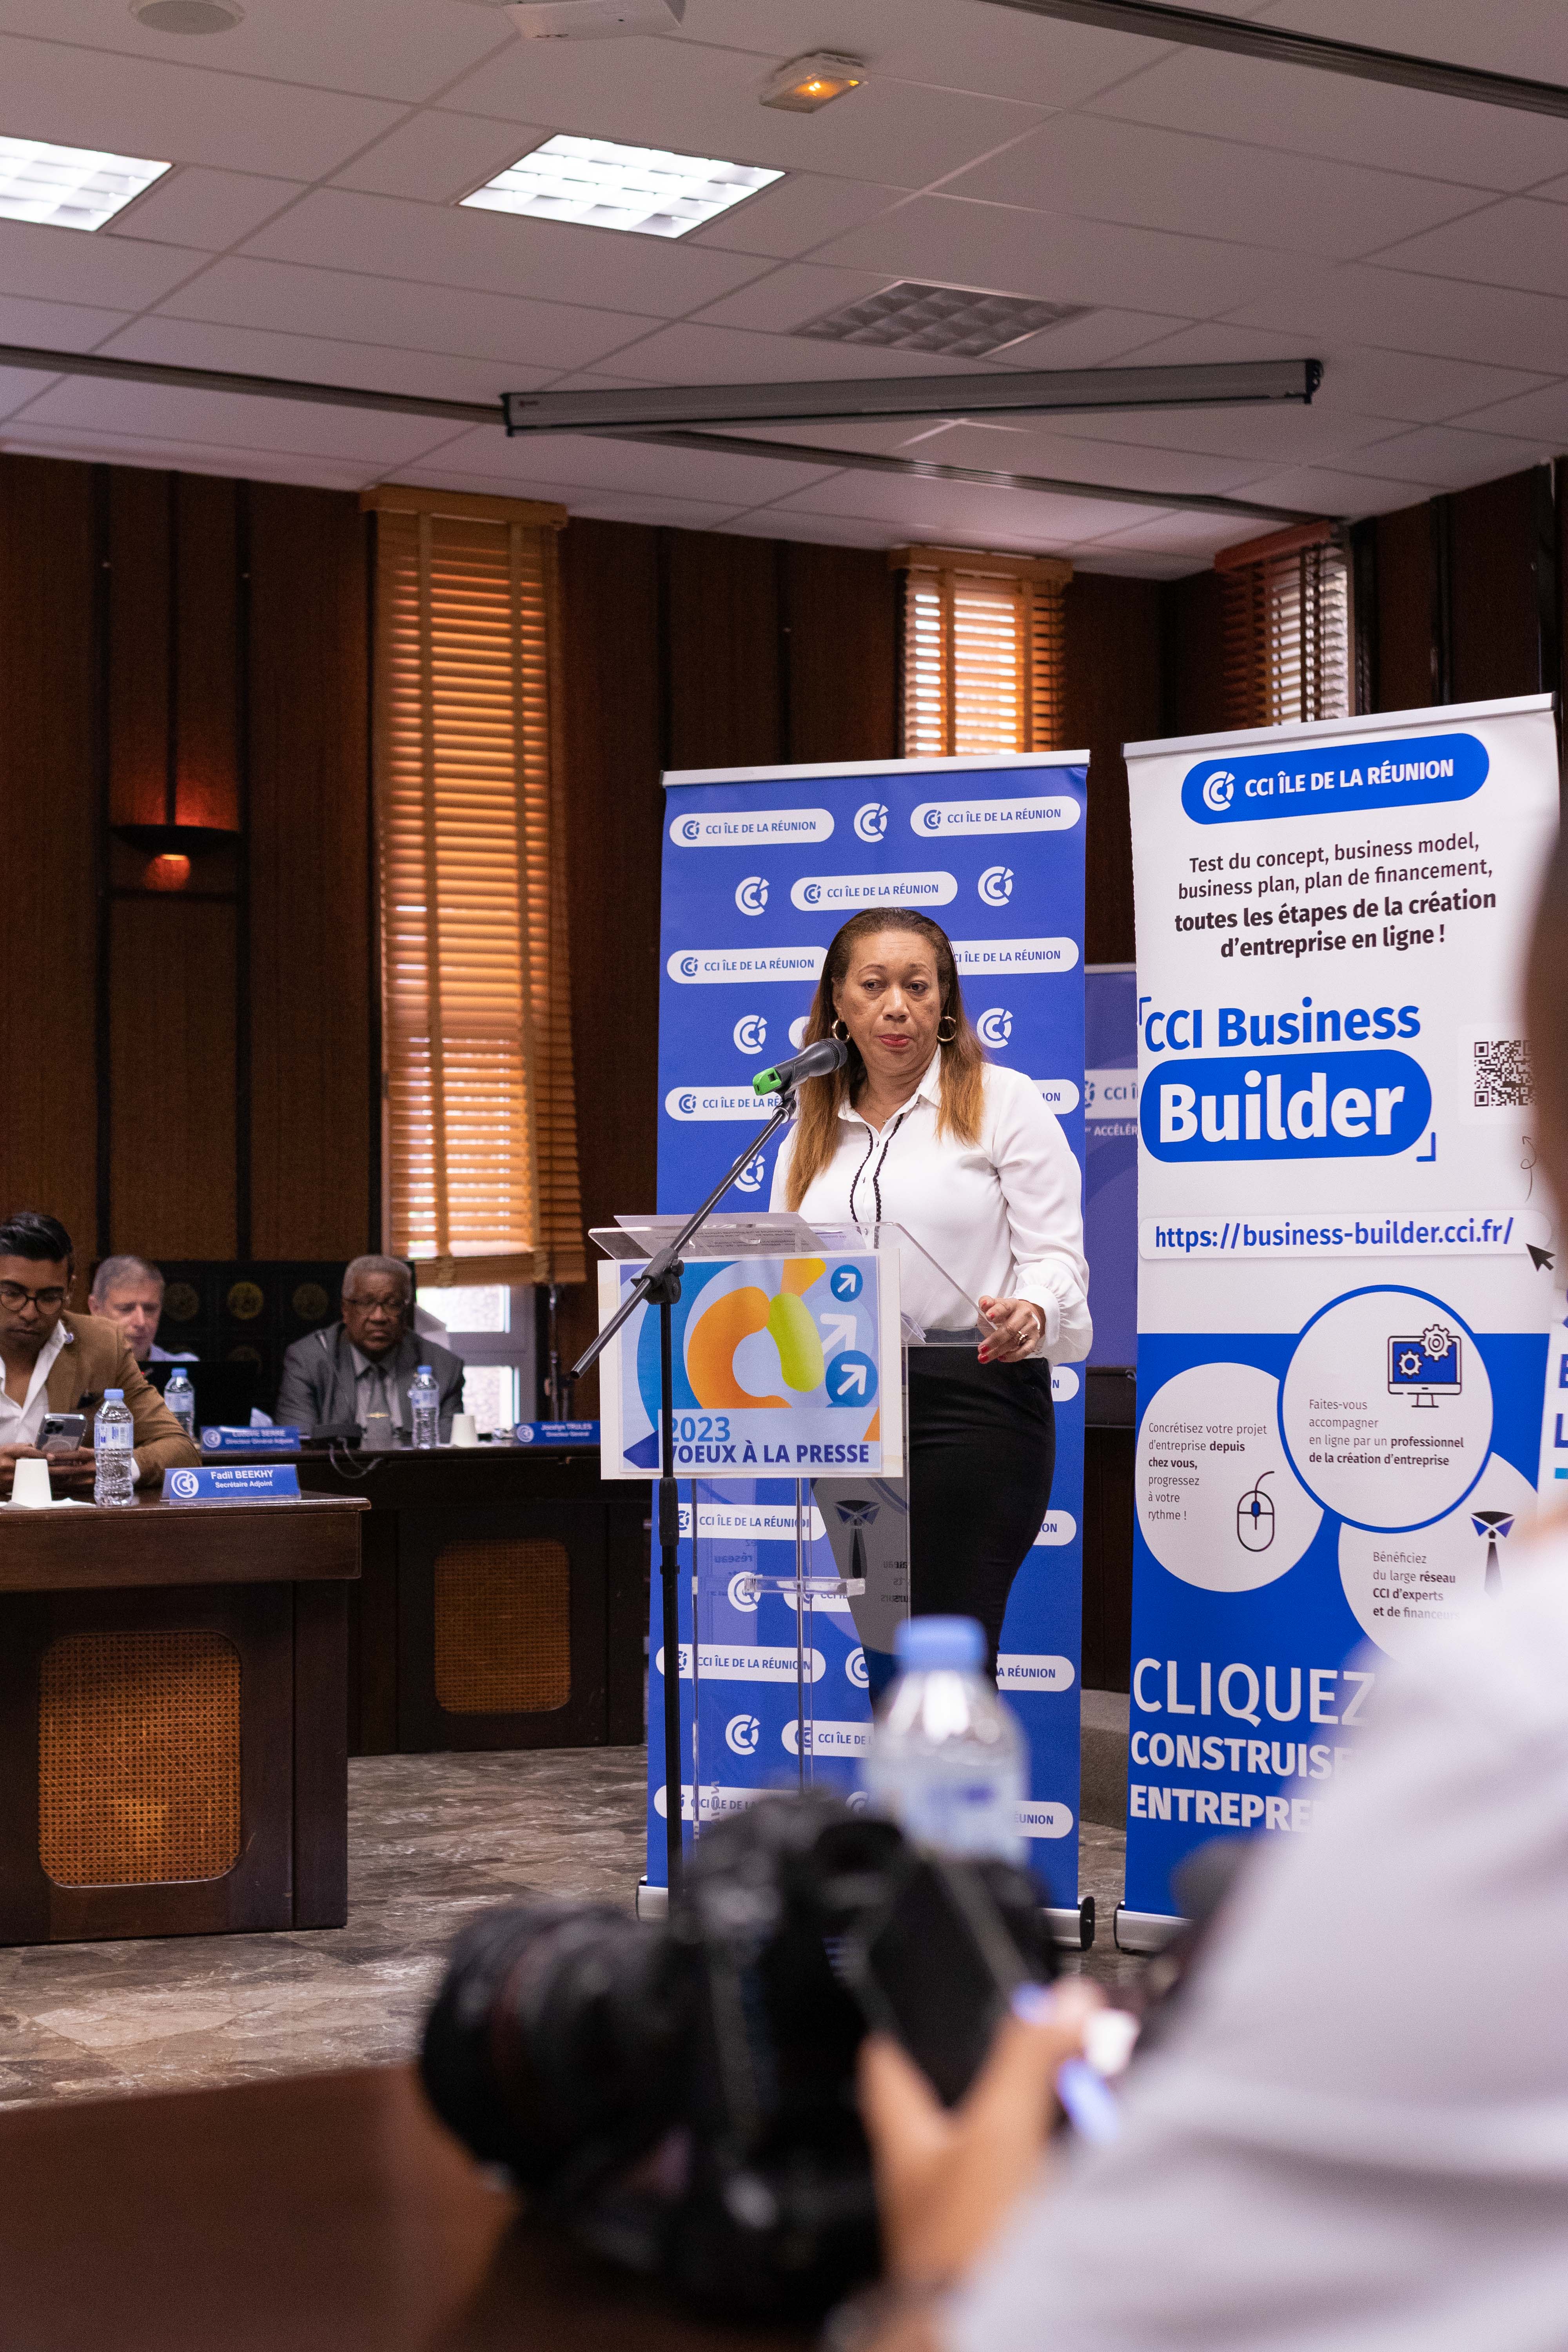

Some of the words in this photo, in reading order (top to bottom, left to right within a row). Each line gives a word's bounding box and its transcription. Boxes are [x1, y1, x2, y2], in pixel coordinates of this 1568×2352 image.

[1245, 778, 1273, 797] CCI
[1278, 771, 1305, 793] ÎLE
[1311, 771, 1334, 790] DE
[1340, 769, 1363, 787] LA
[1368, 759, 1453, 785] RÉUNION
[947, 814, 963, 823] CCI
[966, 811, 981, 822] ÎLE
[985, 813, 997, 821] DE
[1001, 812, 1013, 820] LA
[1016, 808, 1060, 820] RÉUNION
[706, 826, 721, 834] CCI
[724, 822, 739, 833] ÎLE
[742, 824, 753, 833] DE
[757, 824, 768, 832] LA
[771, 820, 816, 831] RÉUNION
[1189, 856, 1223, 873] Test
[1229, 853, 1250, 869] du
[1257, 848, 1328, 867] concept,
[1335, 840, 1412, 860] business
[1419, 831, 1479, 853] model,
[1179, 879, 1252, 899] business
[1259, 876, 1299, 897] plan,
[1305, 871, 1341, 893] plan
[1348, 868, 1369, 885] de
[1375, 859, 1492, 883] financement,
[828, 889, 842, 897] CCI
[845, 886, 860, 897] ÎLE
[863, 887, 875, 896] DE
[878, 887, 890, 895] LA
[893, 883, 938, 894] RÉUNION
[1175, 912, 1238, 932] toutes
[1244, 907, 1273, 927] les
[1279, 903, 1347, 927] étapes
[1353, 898, 1378, 918] de
[1385, 897, 1403, 916] la
[1409, 888, 1495, 914] création
[1221, 930, 1346, 958] d'entreprise
[1352, 935, 1376, 949] en
[1383, 925, 1434, 951] ligne
[965, 951, 980, 962] ÎLE
[984, 953, 996, 962] DE
[1000, 953, 1012, 961] LA
[1015, 949, 1060, 960] RÉUNION
[704, 962, 719, 971] CCI
[722, 959, 737, 971] ÎLE
[740, 962, 752, 970] DE
[755, 961, 766, 969] LA
[769, 958, 814, 969] RÉUNION
[1145, 1010, 1202, 1052] CCI
[1219, 997, 1420, 1047] Business
[1104, 1087, 1127, 1100] CCI
[703, 1100, 718, 1108] CCI
[721, 1097, 735, 1108] ÎLE
[738, 1099, 750, 1107] DE
[753, 1099, 764, 1107] LA
[1160, 1070, 1405, 1143] Builder
[1156, 1217, 1514, 1252] https://business-builder.cci.fr/
[1310, 1399, 1367, 1410] Faites-vous
[1149, 1422, 1203, 1433] Concrétisez
[1206, 1425, 1233, 1434] votre
[1237, 1424, 1267, 1436] projet
[1309, 1419, 1378, 1430] accompagner
[1149, 1440, 1206, 1453] d'entreprise
[1210, 1441, 1245, 1454] depuis
[1325, 1434, 1350, 1448] ligne
[1354, 1438, 1371, 1448] par
[1391, 1436, 1464, 1448] professionnel
[742, 1440, 757, 1463] À
[764, 1445, 789, 1463] LA
[797, 1445, 868, 1463] PRESSE
[1149, 1457, 1168, 1467] chez
[1171, 1460, 1197, 1470] vous,
[1309, 1452, 1322, 1462] de
[1325, 1453, 1334, 1463] la
[1337, 1452, 1381, 1463] création
[1384, 1454, 1449, 1467] d'entreprise
[235, 1470, 273, 1479] BEEKHY
[1149, 1477, 1199, 1487] progressez
[1148, 1491, 1152, 1501] à
[1156, 1494, 1180, 1503] votre
[699, 1517, 714, 1525] CCI
[717, 1514, 731, 1526] ÎLE
[735, 1517, 746, 1526] DE
[750, 1518, 761, 1526] LA
[1149, 1510, 1180, 1521] rythme
[1373, 1551, 1426, 1564] Bénéficiez
[1373, 1570, 1386, 1580] du
[1390, 1570, 1416, 1584] large
[1420, 1571, 1455, 1583] réseau
[1373, 1588, 1389, 1598] CCI
[1393, 1588, 1443, 1602] d'experts
[1373, 1607, 1384, 1616] et
[1387, 1606, 1400, 1617] de
[715, 1655, 729, 1667] ÎLE
[733, 1659, 744, 1667] DE
[748, 1659, 759, 1668] LA
[997, 1668, 1004, 1677] A
[1008, 1665, 1055, 1678] RÉUNION
[1133, 1658, 1374, 1727] CLIQUEZ
[818, 1734, 833, 1743] CCI
[837, 1731, 851, 1744] ÎLE
[1015, 1813, 1053, 1824] UNION
